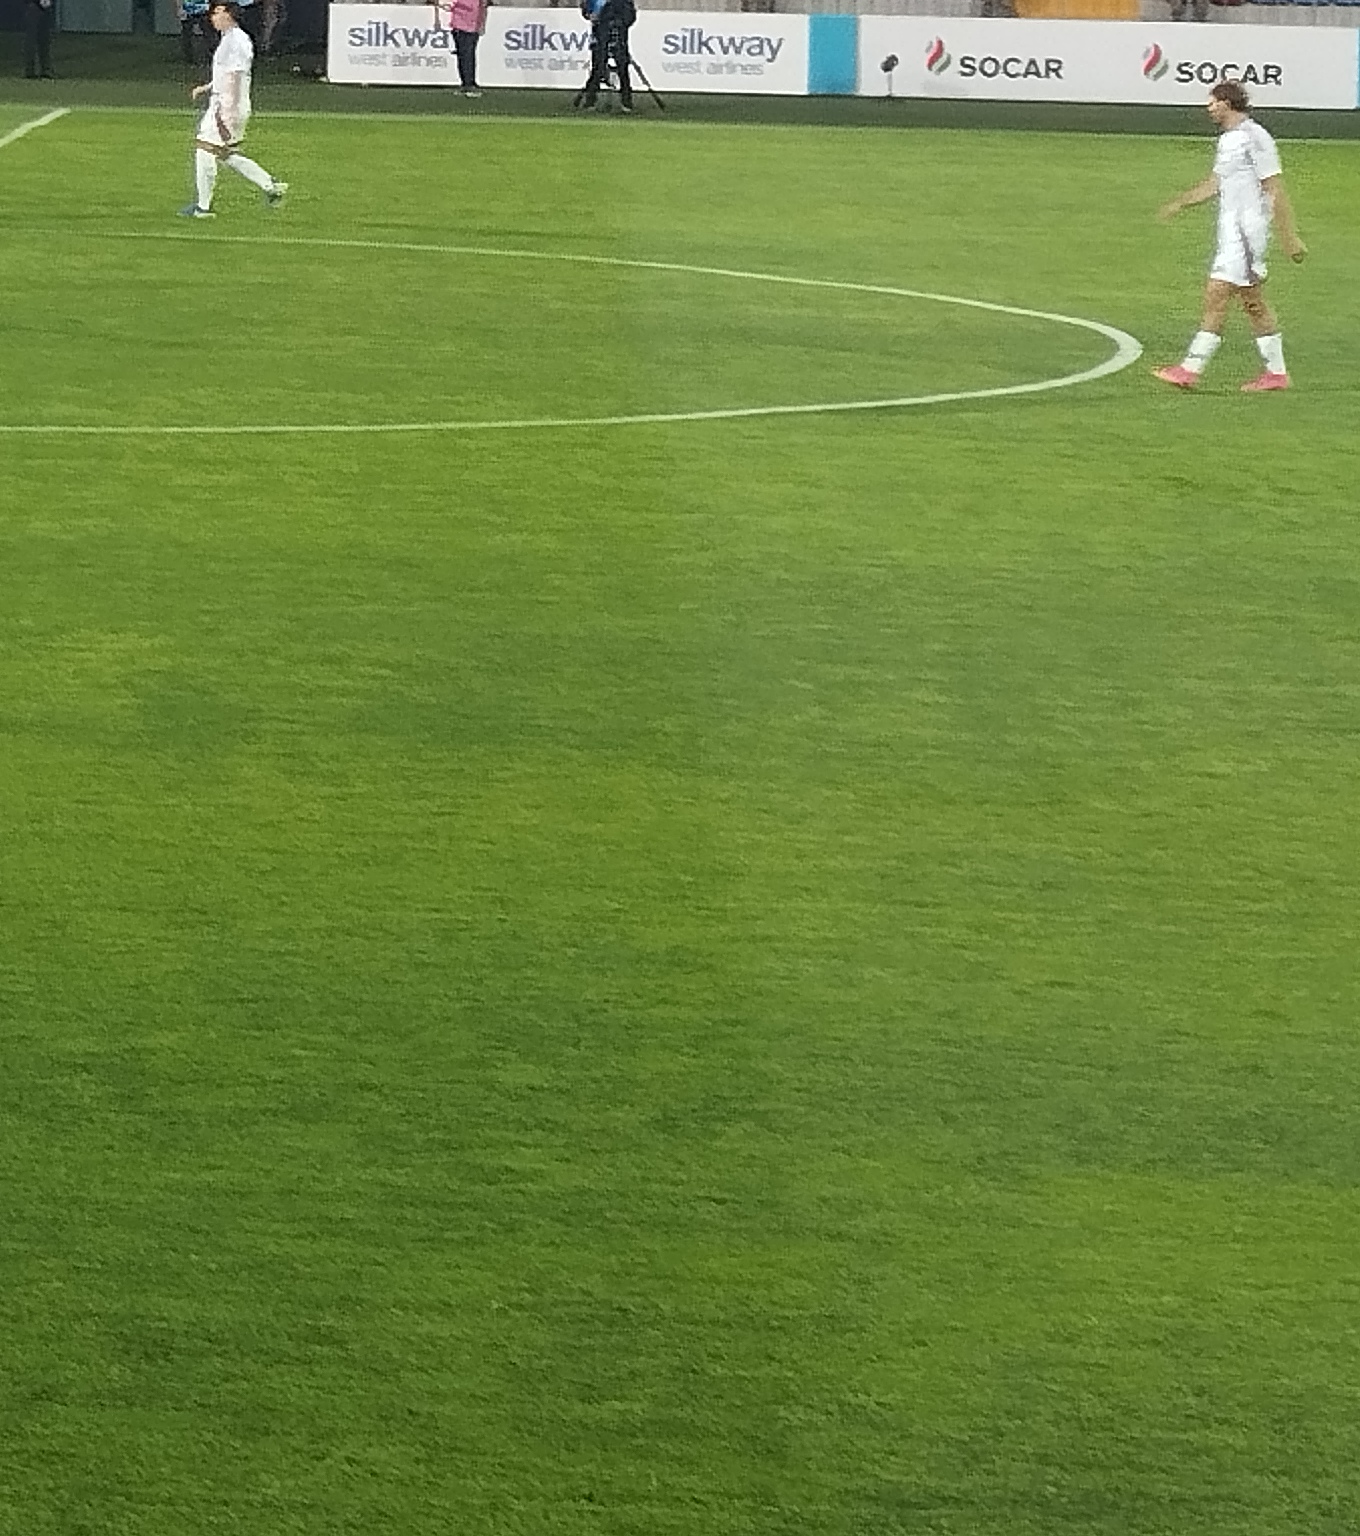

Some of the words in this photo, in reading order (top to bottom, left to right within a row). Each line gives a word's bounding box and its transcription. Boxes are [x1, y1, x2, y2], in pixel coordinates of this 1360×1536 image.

[348, 20, 456, 53] silkwa
[504, 23, 591, 51] silkw
[662, 27, 785, 63] silkway
[959, 56, 1063, 80] SOCAR
[1174, 62, 1283, 85] SOCAR
